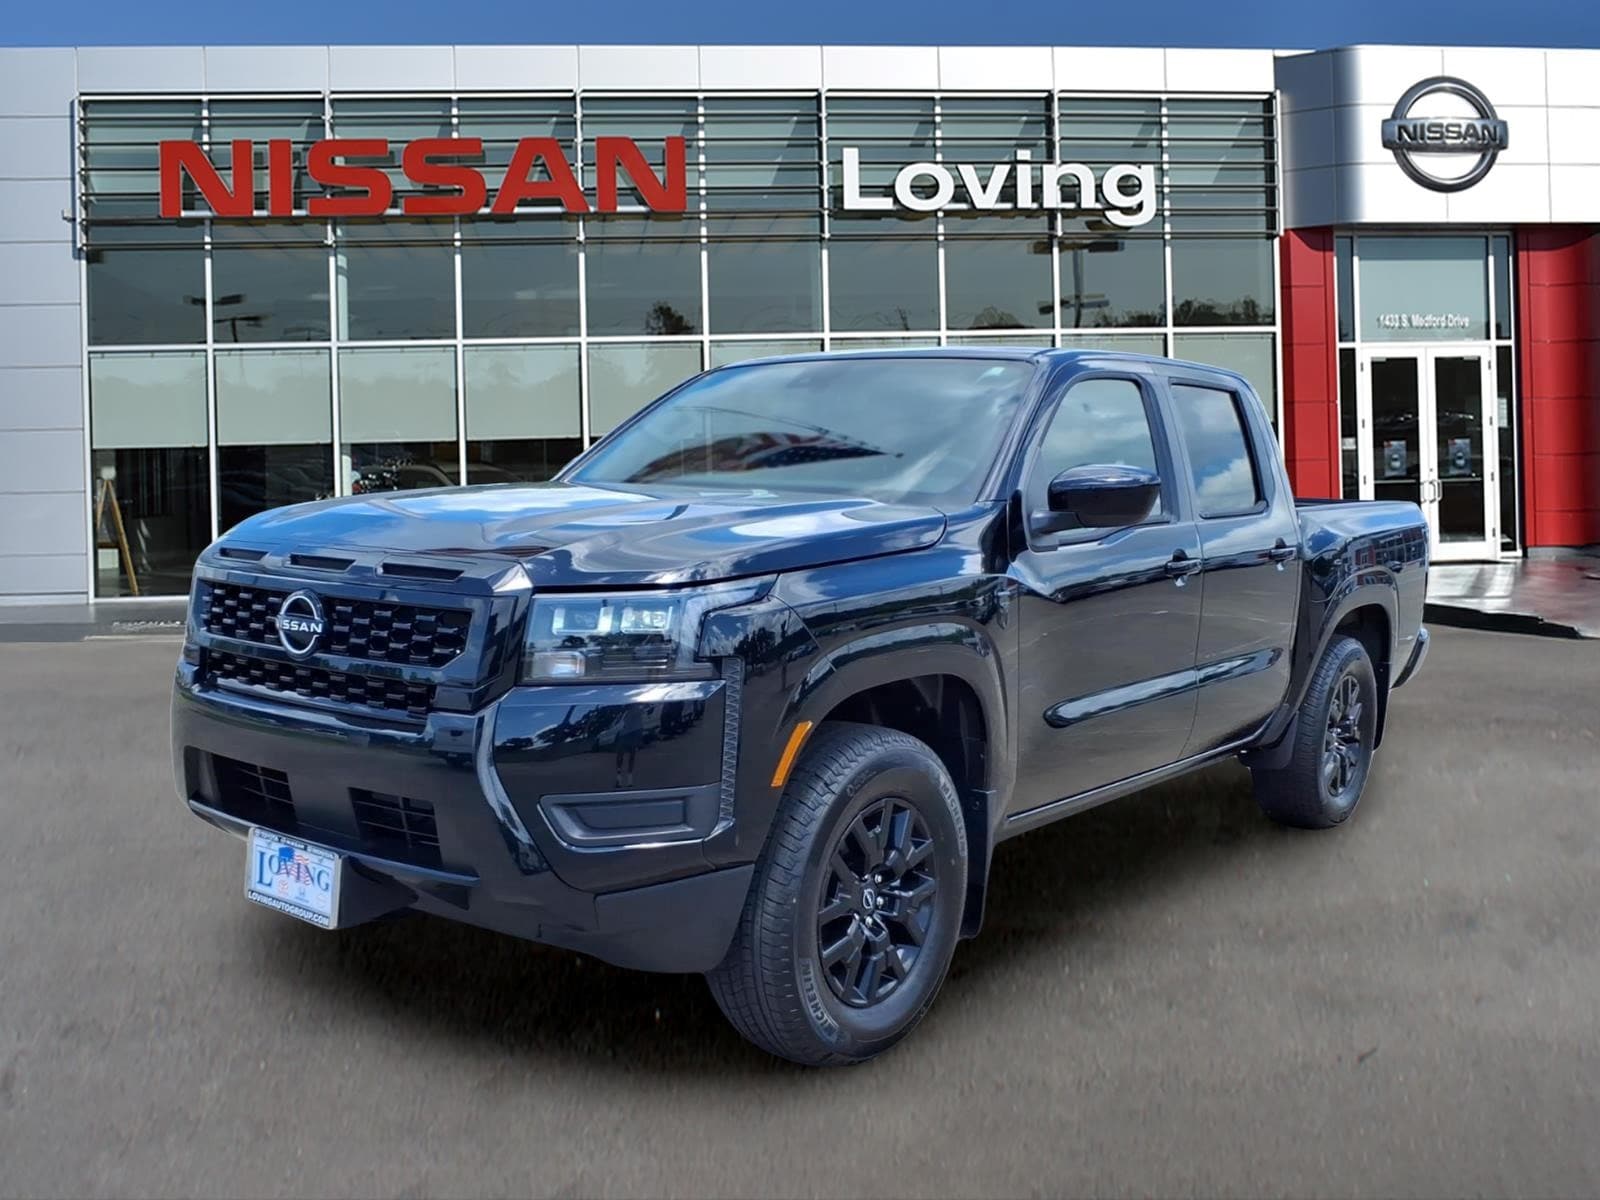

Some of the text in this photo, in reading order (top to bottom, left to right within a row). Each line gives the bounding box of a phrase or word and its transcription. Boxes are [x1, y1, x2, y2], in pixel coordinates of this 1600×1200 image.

[1396, 122, 1498, 143] NISSAN
[159, 136, 687, 218] NISSAN
[842, 147, 1157, 227] Loving
[257, 851, 331, 892] LOVING
[247, 890, 330, 926] LOVINGAUTOGROUP.COM
